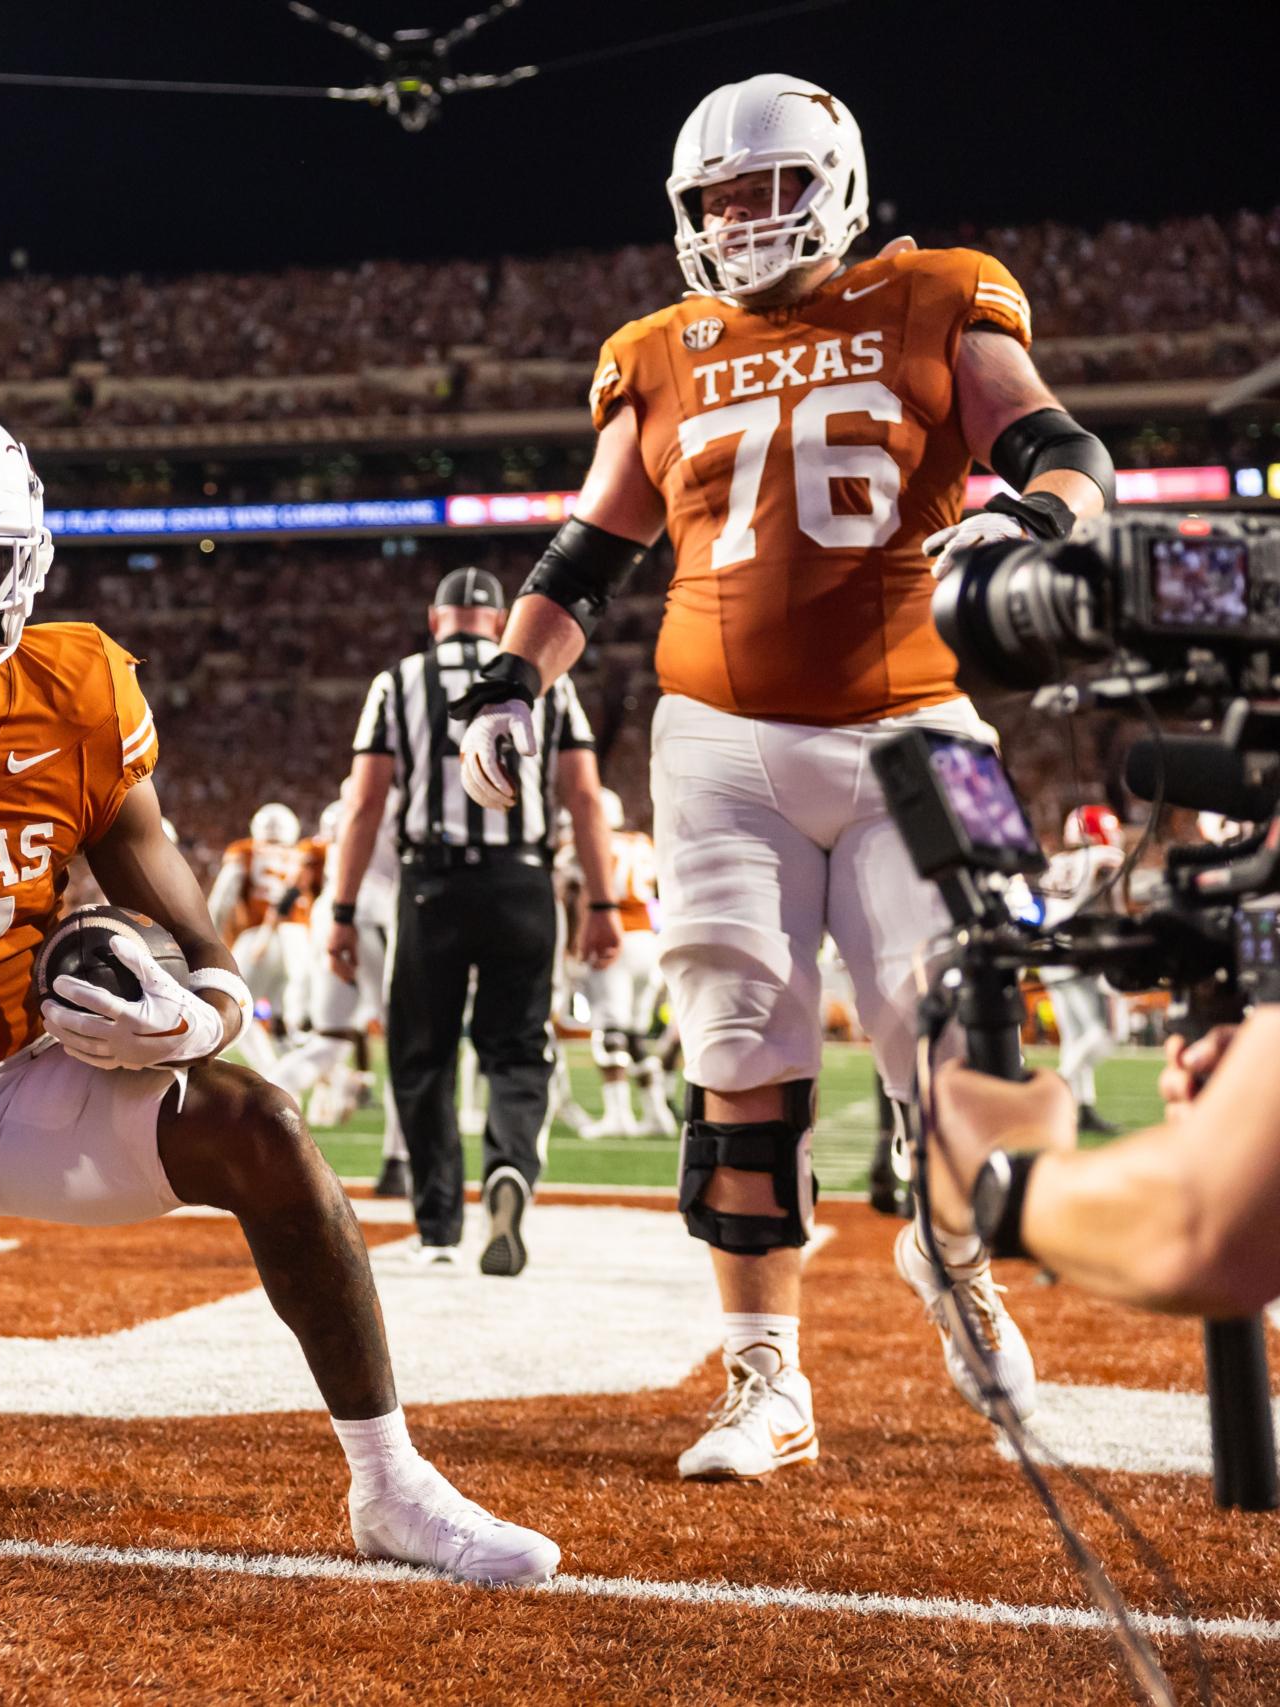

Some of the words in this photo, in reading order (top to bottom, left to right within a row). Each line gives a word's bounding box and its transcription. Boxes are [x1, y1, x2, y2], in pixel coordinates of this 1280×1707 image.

[683, 318, 722, 350] SEC
[693, 330, 883, 406] TEXAS
[678, 380, 902, 570] 76
